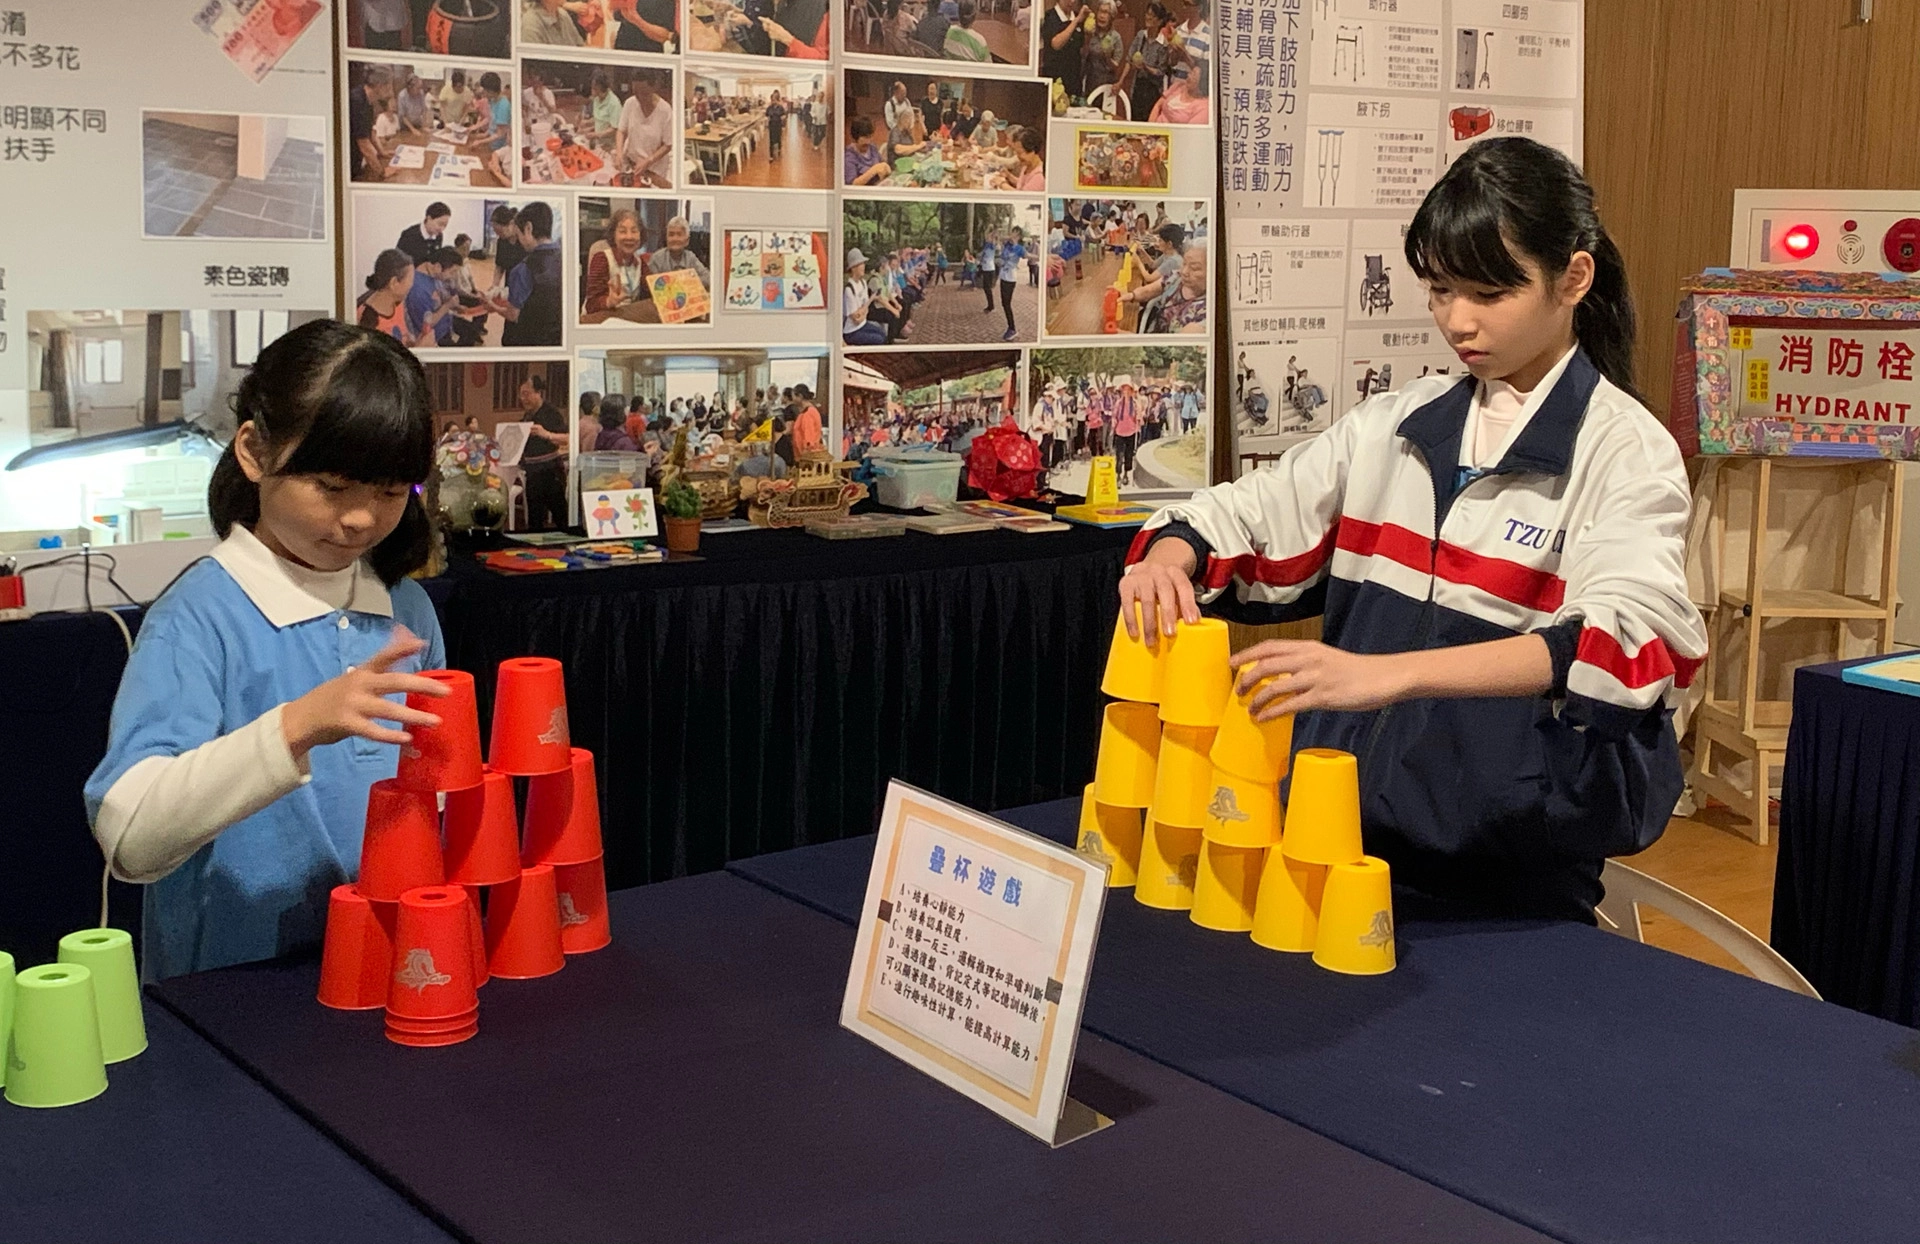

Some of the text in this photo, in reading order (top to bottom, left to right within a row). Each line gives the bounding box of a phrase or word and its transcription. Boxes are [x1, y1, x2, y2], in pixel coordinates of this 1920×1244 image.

[0, 42, 80, 70] 不多花
[0, 105, 107, 133] 明顯不同
[5, 136, 55, 162] 扶手
[204, 265, 290, 288] 素色瓷磚
[1778, 334, 1915, 381] 消防栓
[1776, 393, 1911, 423] HYDRANT
[1504, 518, 1552, 549] TZU
